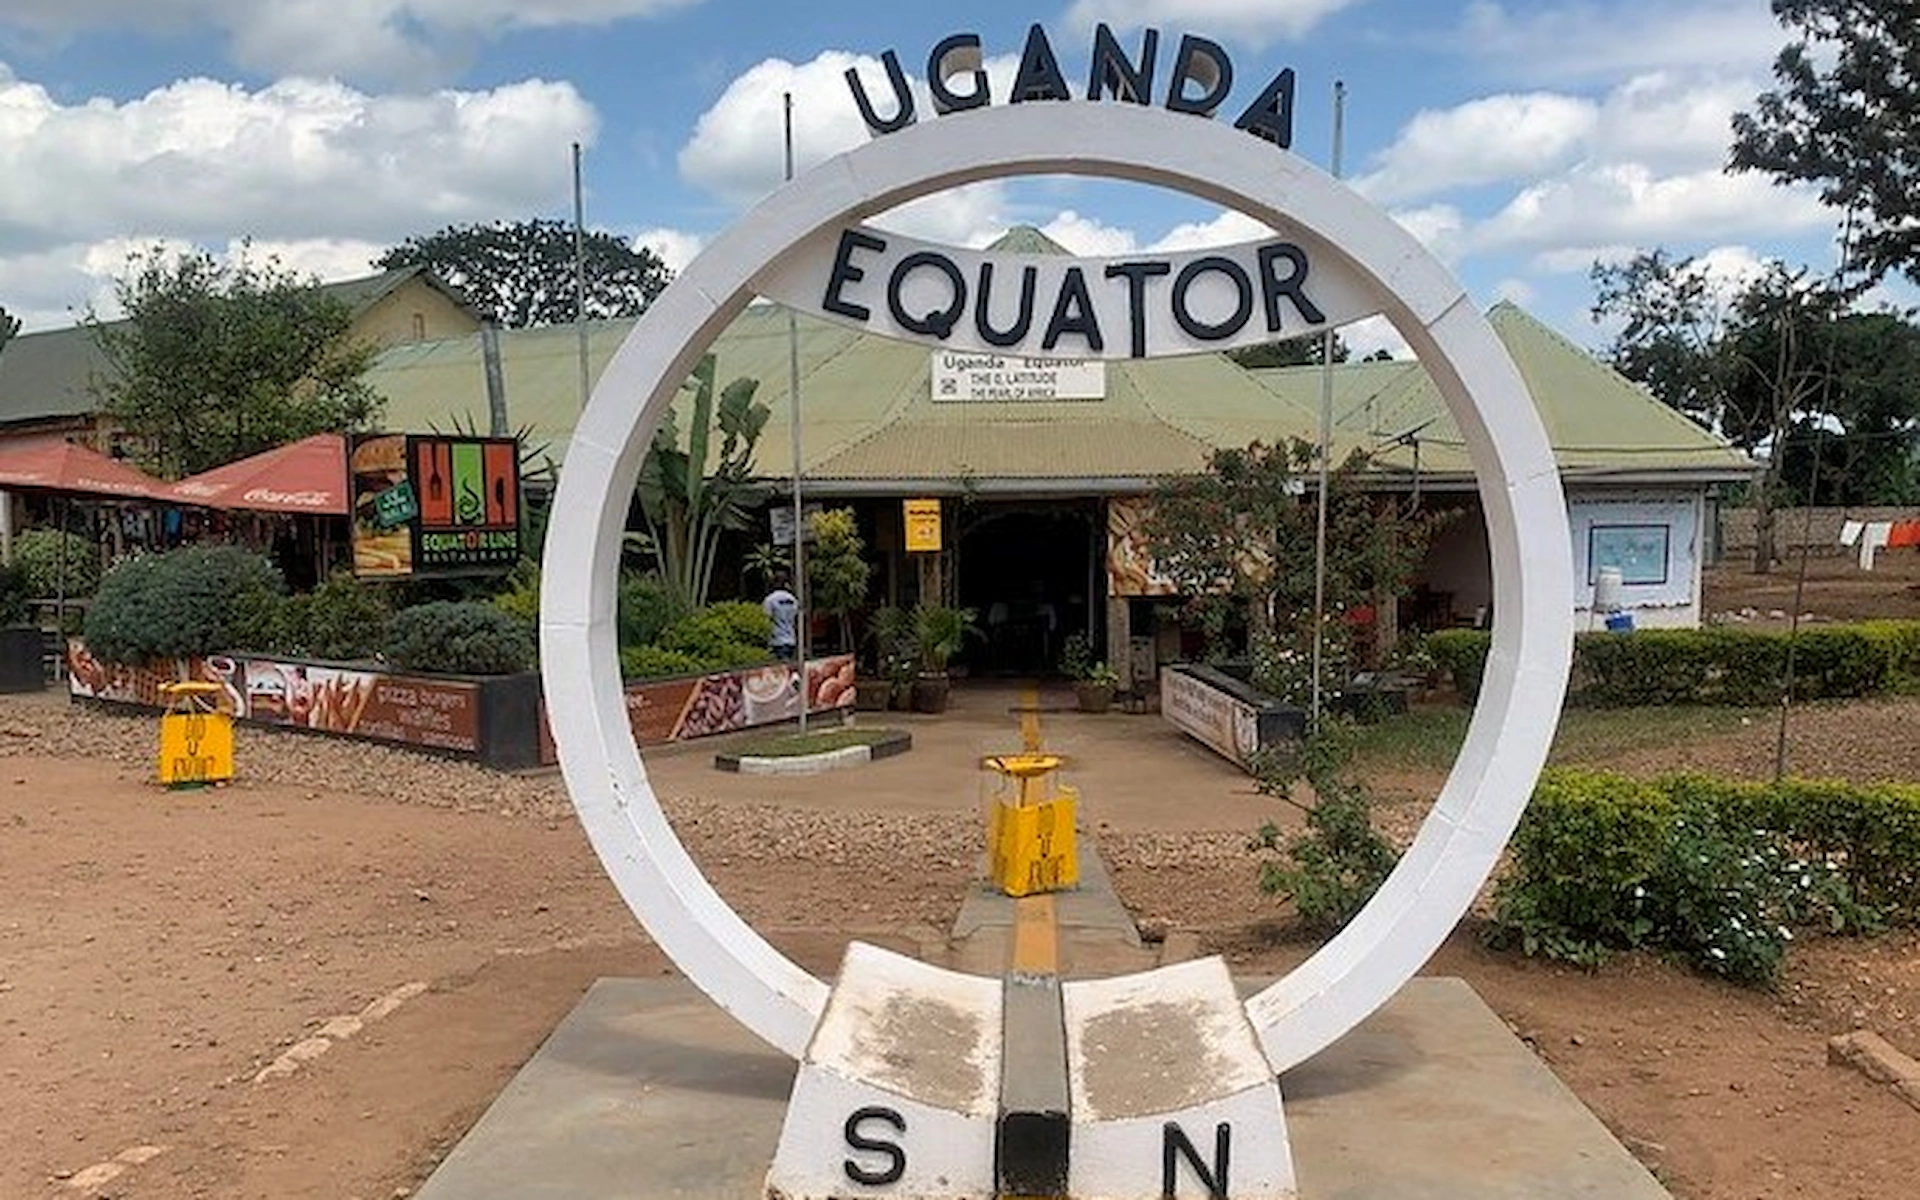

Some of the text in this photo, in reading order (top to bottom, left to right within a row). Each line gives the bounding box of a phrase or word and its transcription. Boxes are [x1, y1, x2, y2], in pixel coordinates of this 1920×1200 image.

[844, 22, 1296, 150] UGANDA
[822, 229, 1325, 358] EQUATOR
[943, 353, 1005, 372] Uganda
[844, 1106, 906, 1187] S
[1163, 1121, 1230, 1198] N
